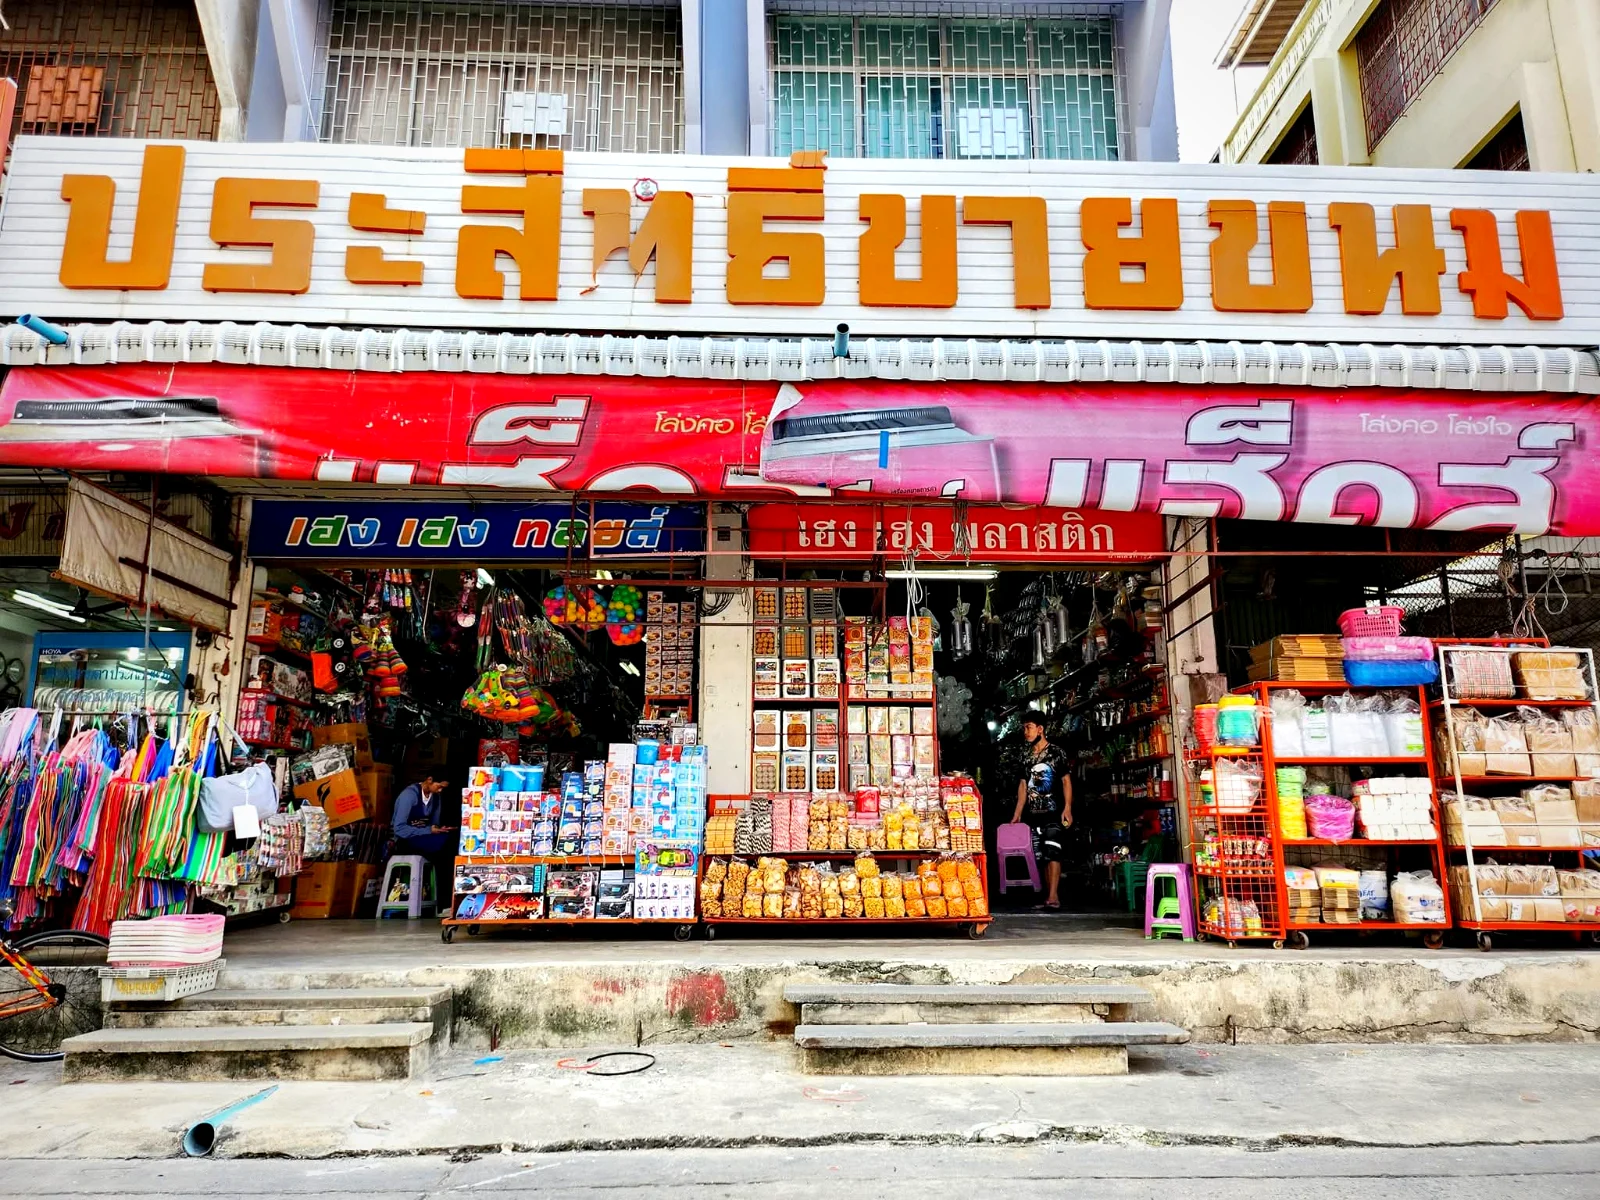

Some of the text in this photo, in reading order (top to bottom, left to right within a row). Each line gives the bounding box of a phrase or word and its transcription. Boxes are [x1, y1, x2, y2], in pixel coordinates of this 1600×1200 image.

[655, 411, 735, 434] โล่งคอ
[1359, 412, 1512, 436] โล่งคอ โล่งใจ
[285, 516, 381, 547] เฮง
[397, 516, 490, 548] เฮง
[798, 520, 856, 548] เฮง
